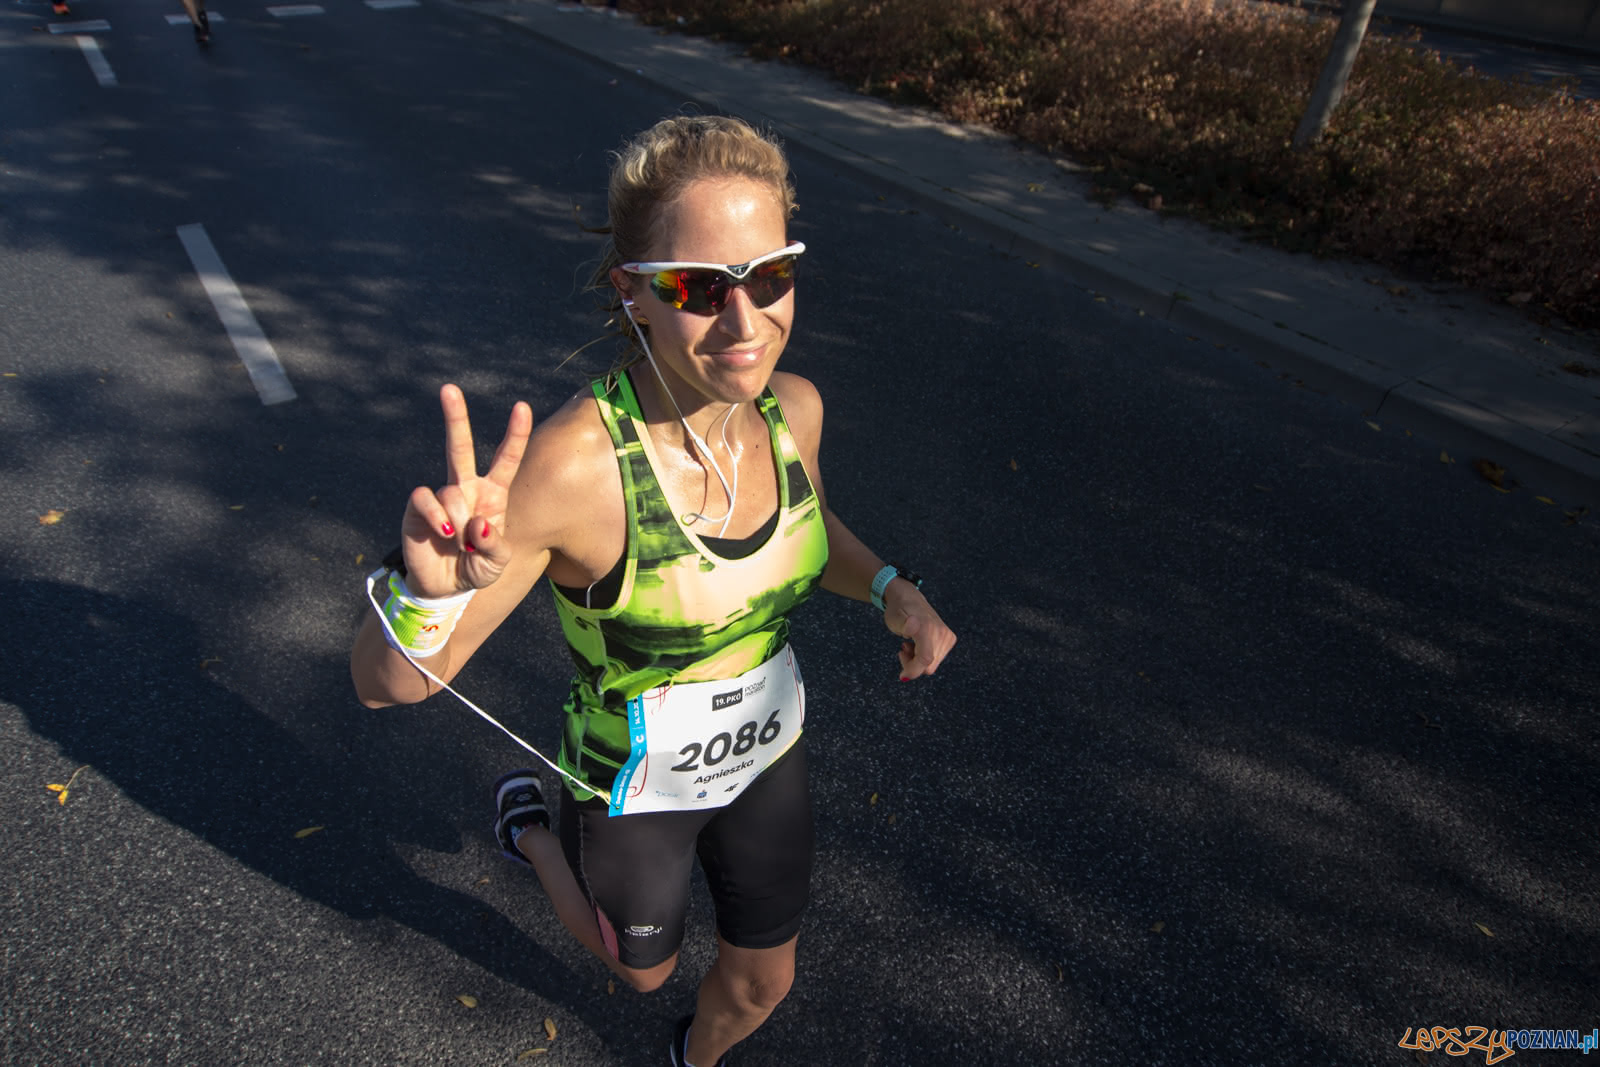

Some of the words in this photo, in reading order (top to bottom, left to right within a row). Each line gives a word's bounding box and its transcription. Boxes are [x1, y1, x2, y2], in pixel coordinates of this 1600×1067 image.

[715, 697, 726, 707] 19.
[726, 692, 742, 704] PKO
[671, 708, 781, 772] 2086
[693, 759, 754, 785] Agnieszka
